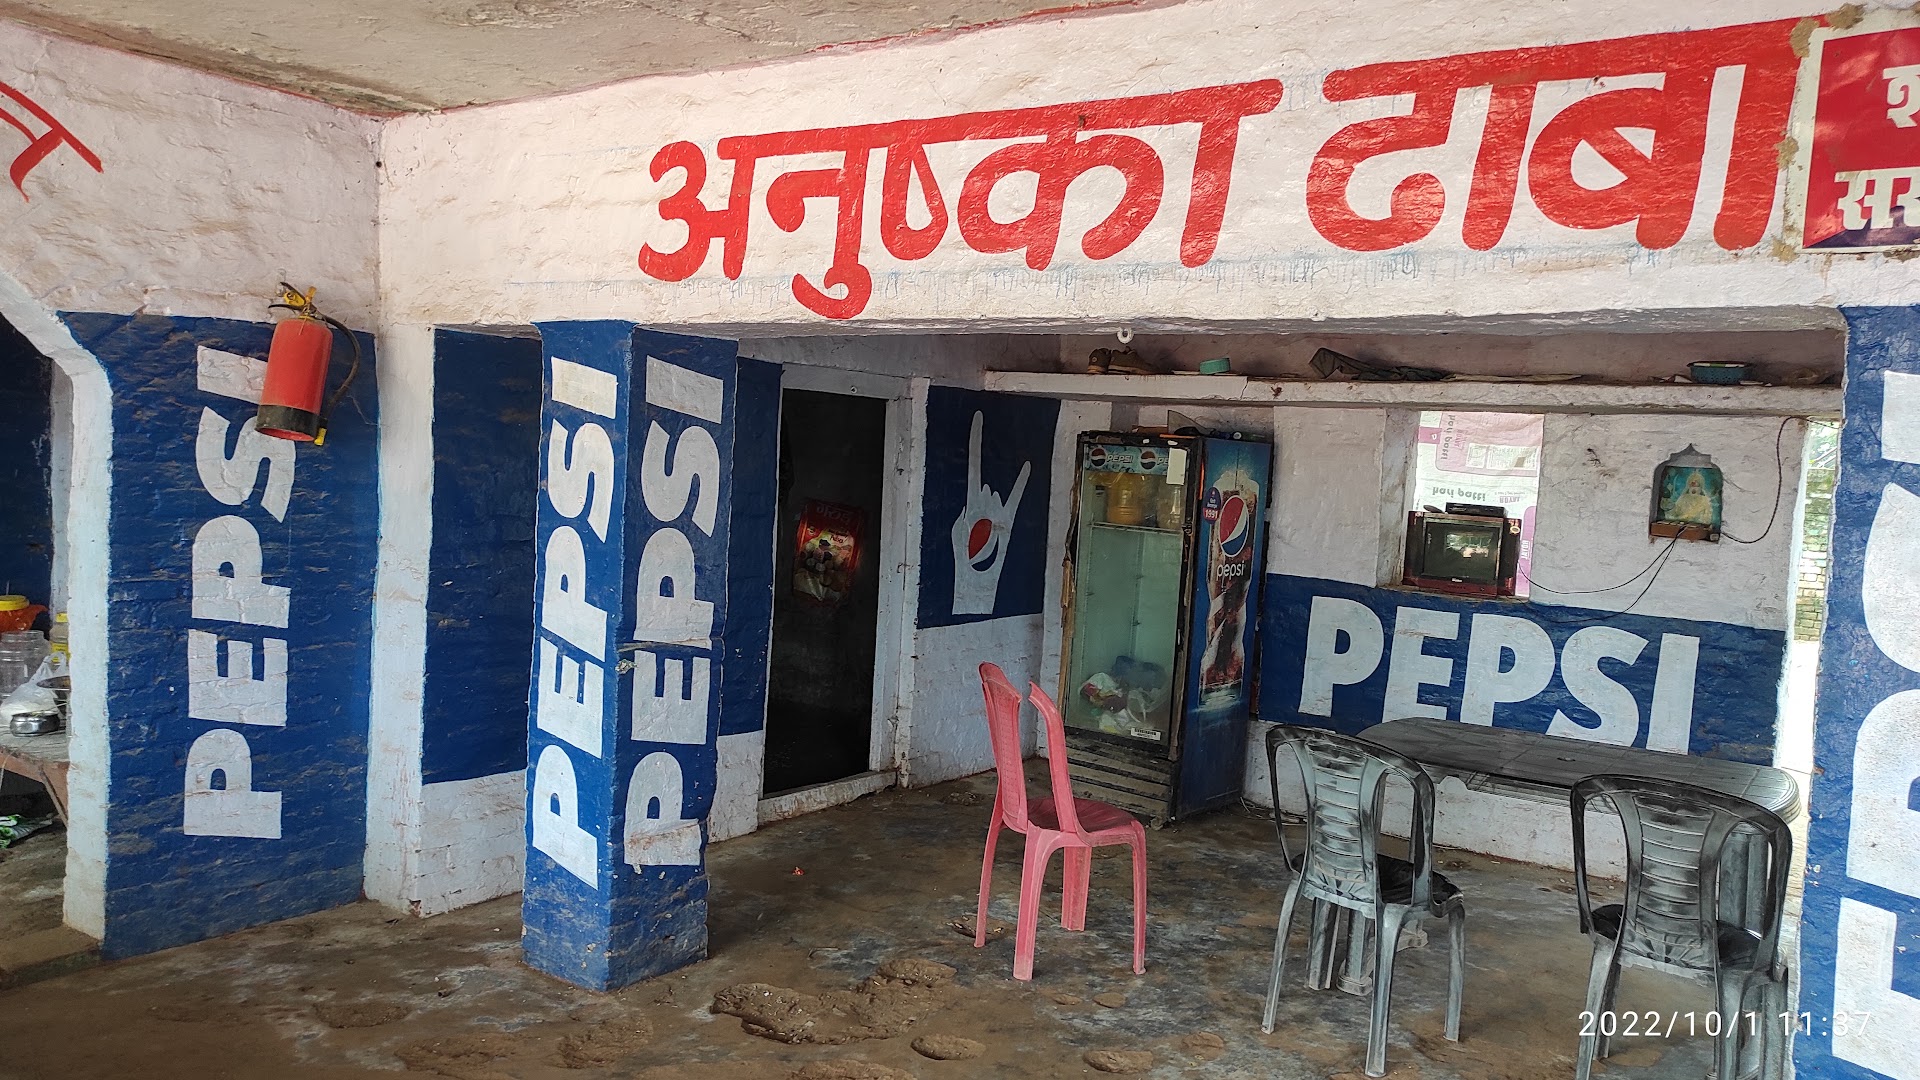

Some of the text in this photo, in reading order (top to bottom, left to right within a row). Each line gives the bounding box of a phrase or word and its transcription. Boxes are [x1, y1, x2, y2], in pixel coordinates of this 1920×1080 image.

[638, 14, 1826, 320] अनुष्का ढाबा
[184, 345, 297, 839] PEPSI
[624, 354, 724, 868] PEPSI
[1106, 454, 1133, 464] PEPSI
[1216, 560, 1245, 581] pepsi
[532, 356, 618, 890] PEPSI
[1298, 596, 1700, 756] PEPSI
